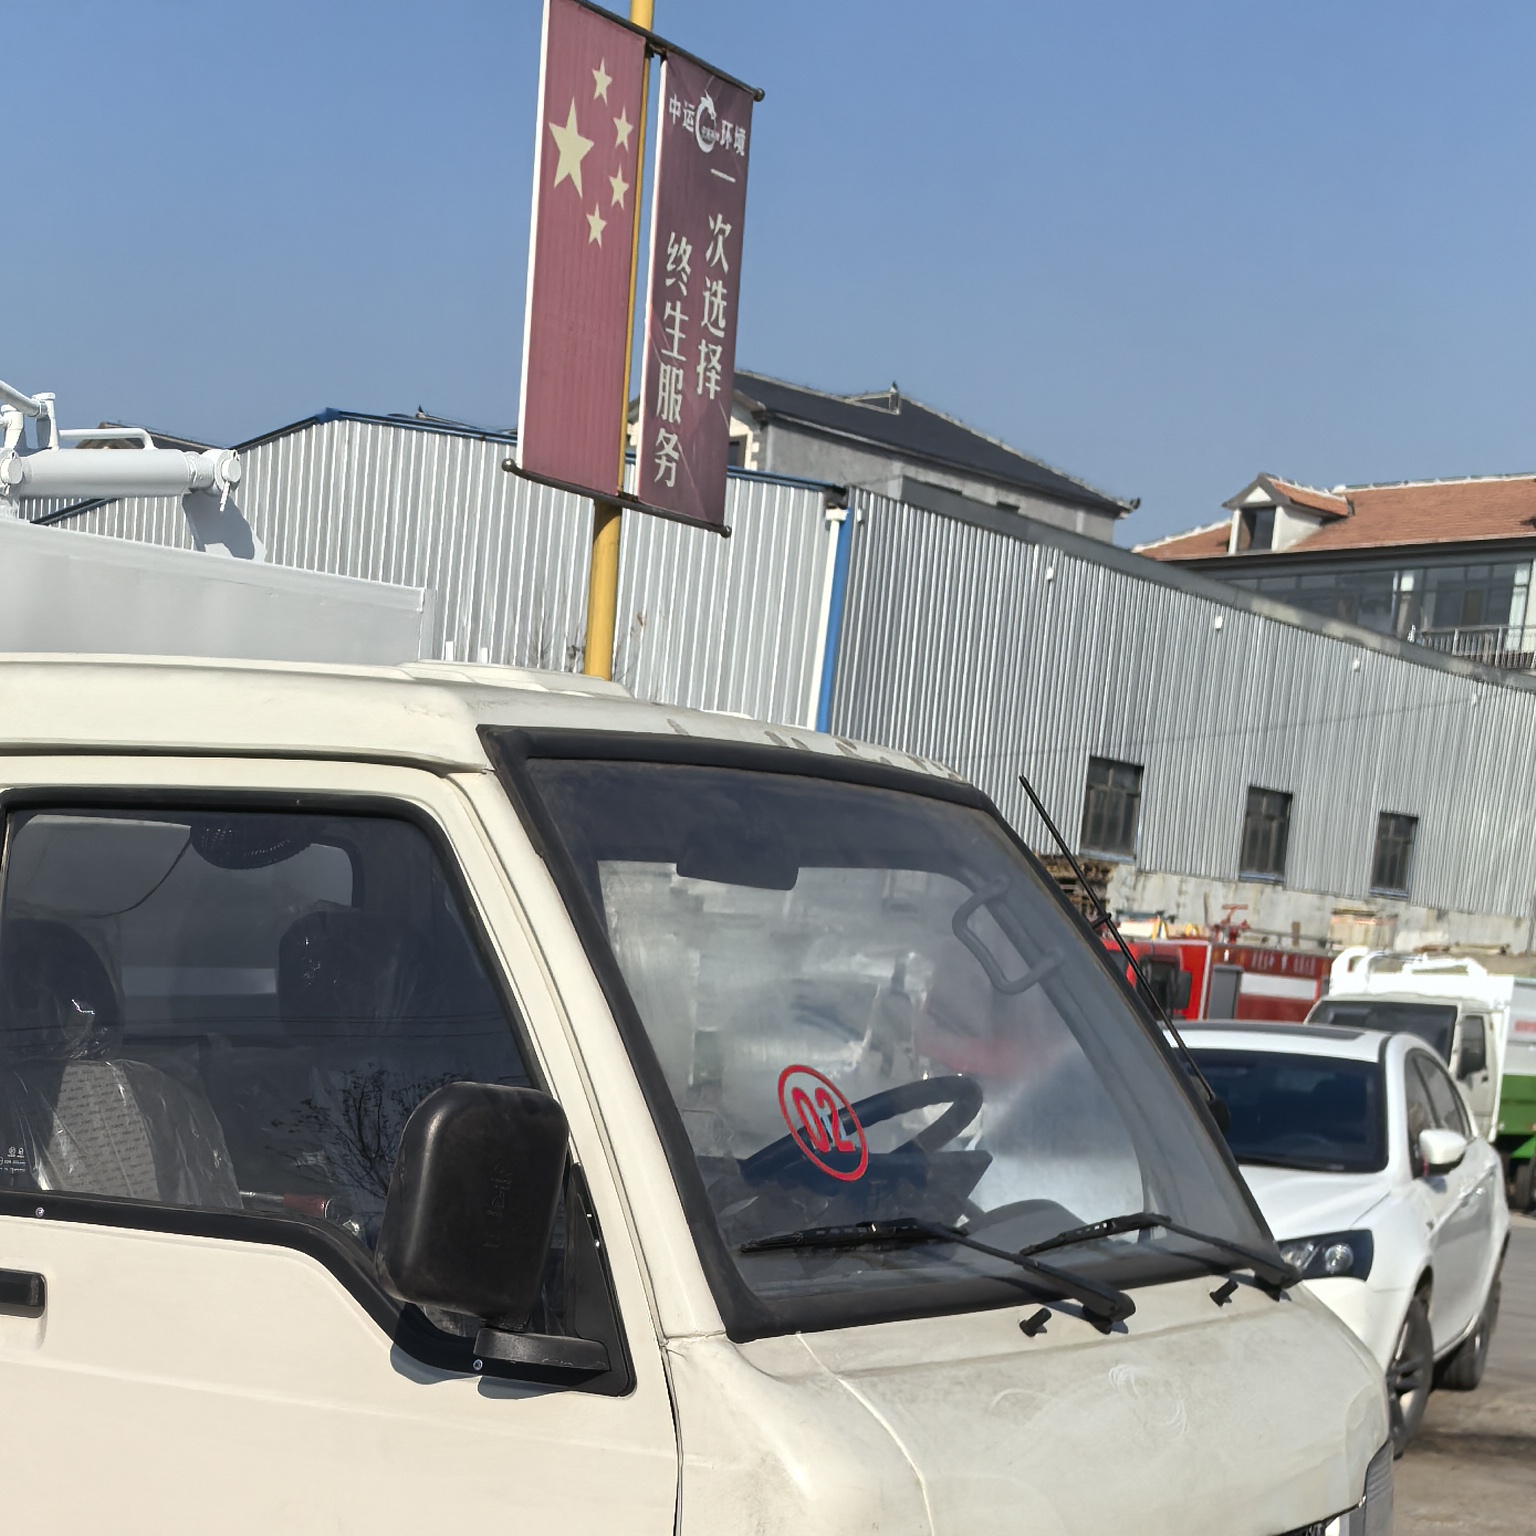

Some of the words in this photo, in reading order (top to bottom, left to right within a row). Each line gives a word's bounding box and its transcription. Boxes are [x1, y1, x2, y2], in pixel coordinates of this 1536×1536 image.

[653, 231, 692, 488] 终生服务
[696, 167, 737, 400] 一次选择
[791, 1086, 857, 1154] 02
